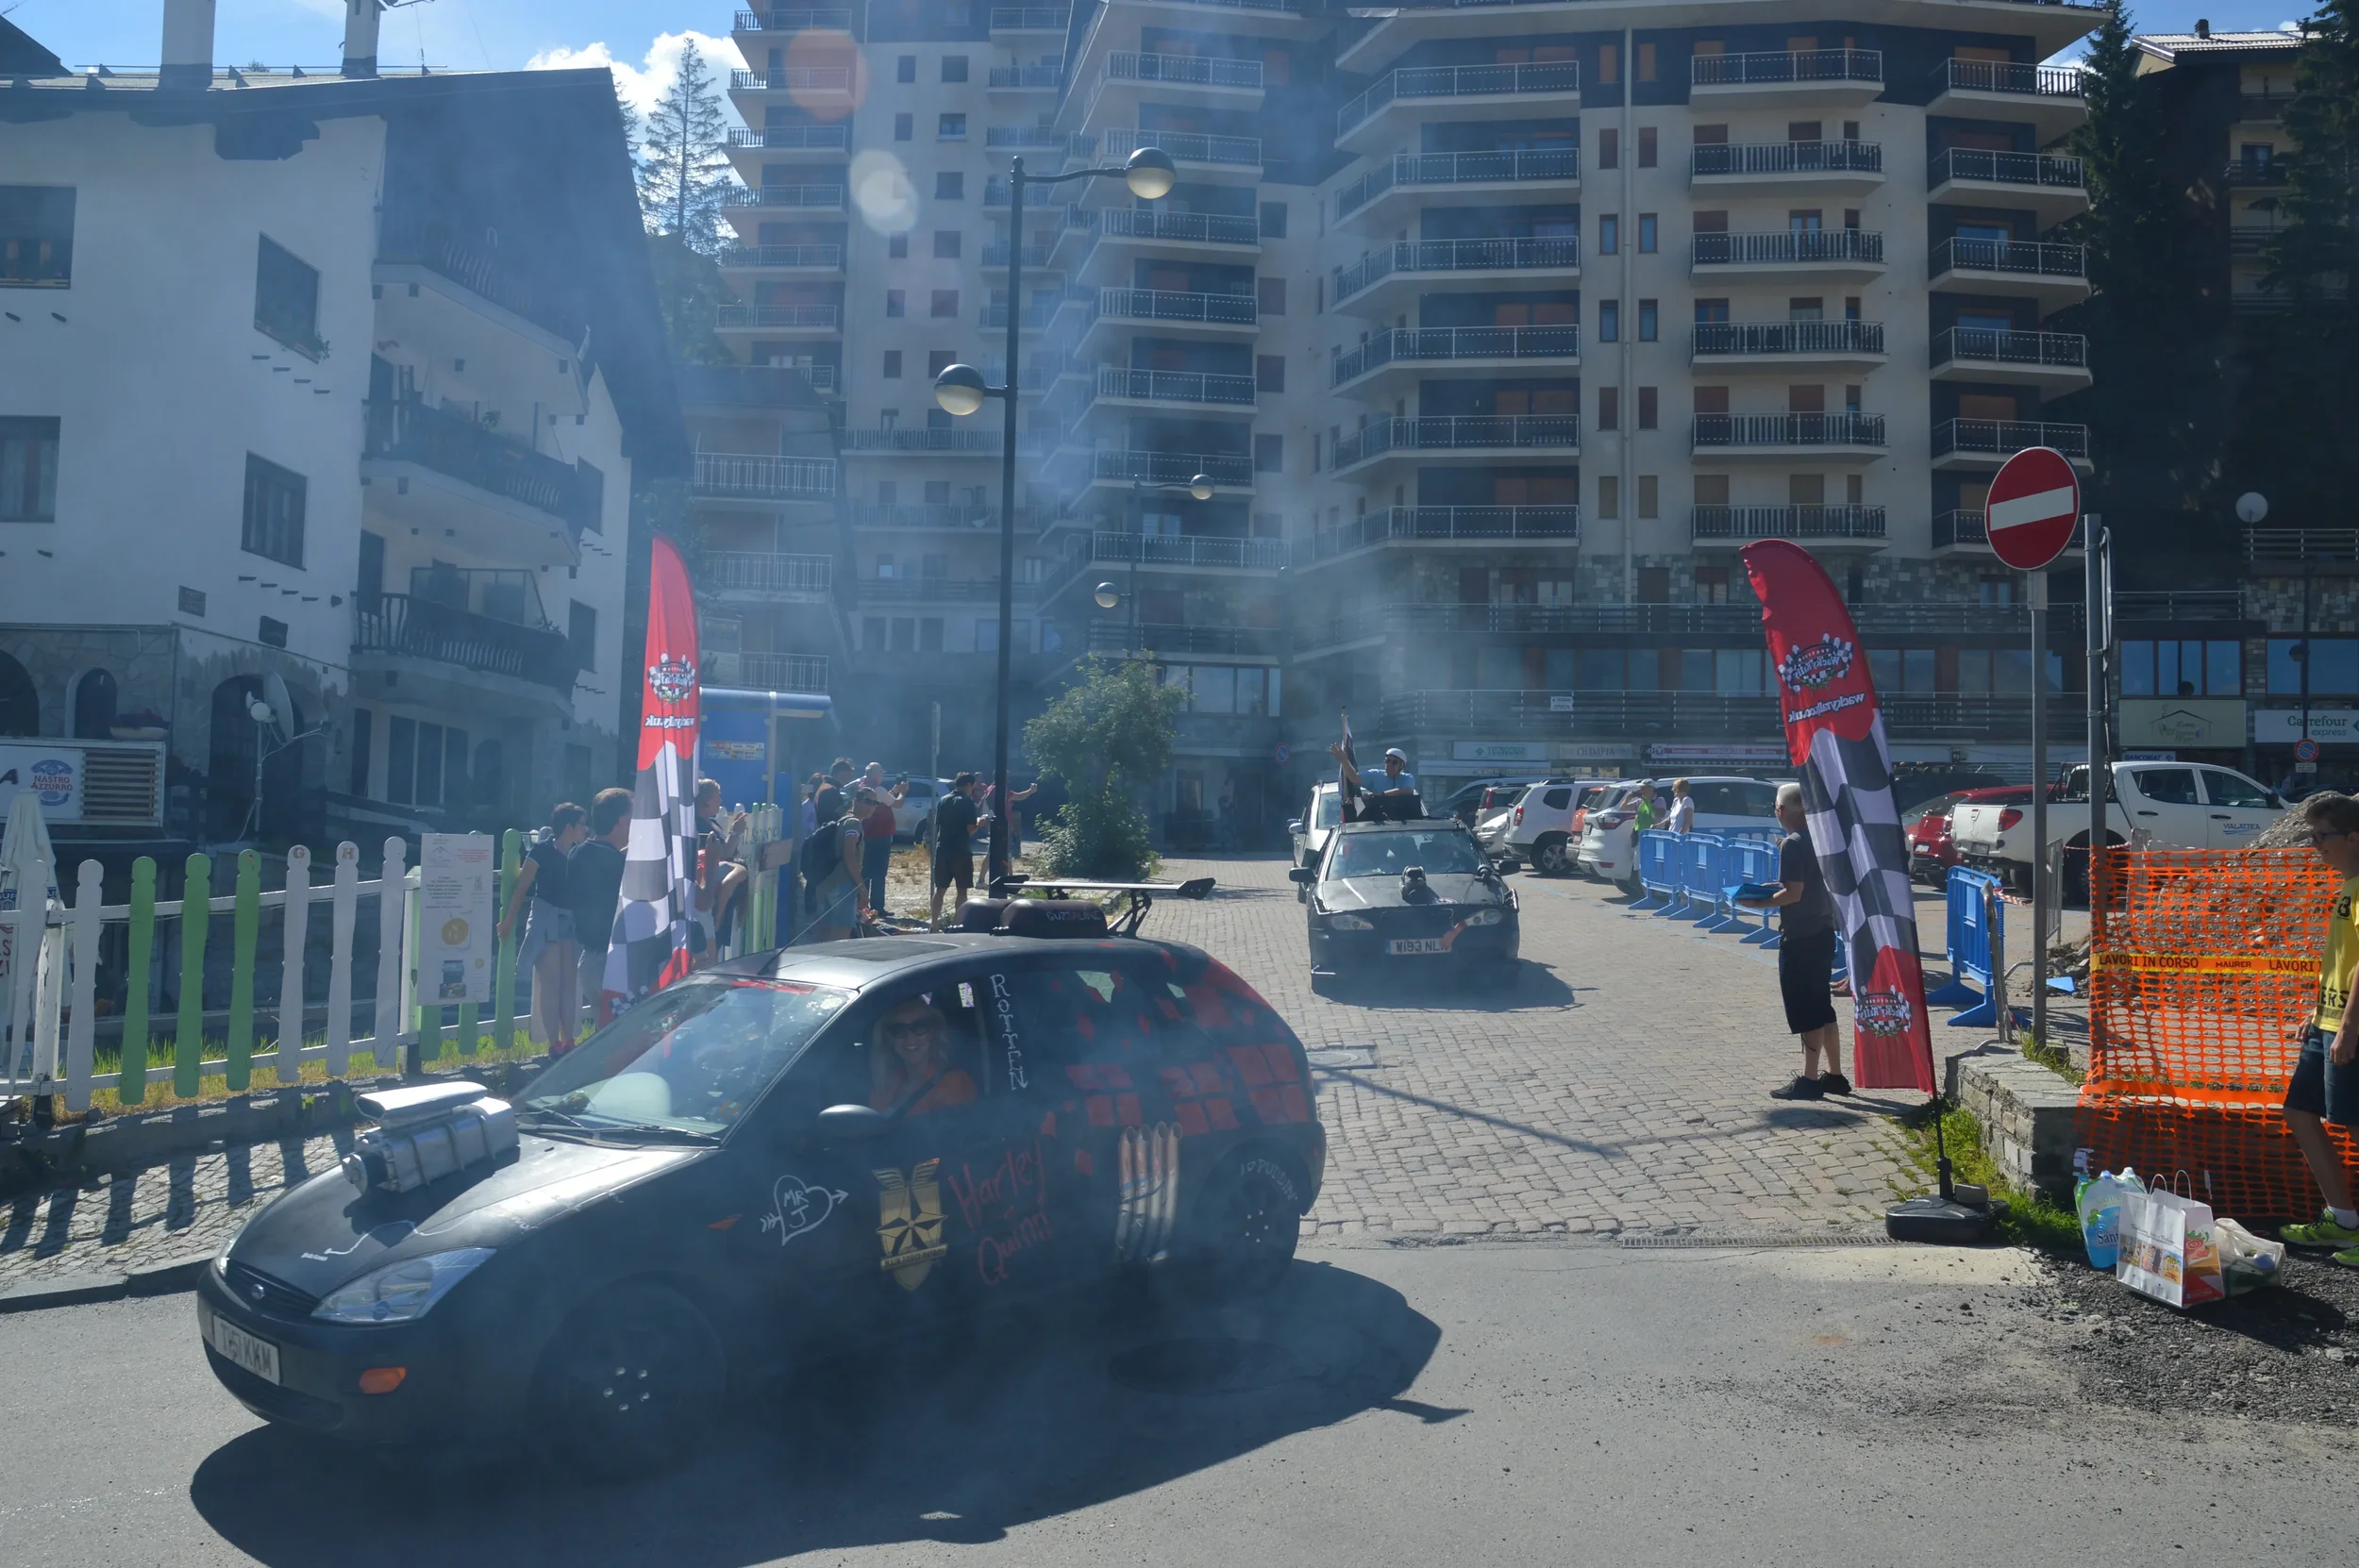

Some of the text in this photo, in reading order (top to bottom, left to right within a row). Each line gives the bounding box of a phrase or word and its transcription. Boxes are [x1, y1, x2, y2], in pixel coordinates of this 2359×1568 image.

[2286, 715, 2348, 726] Carefour
[2312, 728, 2347, 738] express
[1577, 746, 1615, 756] OLIMPIA
[30, 781, 74, 792] AZZURRO
[34, 775, 70, 785] NASTRO
[2100, 954, 2138, 967] LAVORI
[2143, 957, 2155, 967] IN
[2159, 958, 2199, 968] CORSO
[2269, 959, 2315, 972] LAVORI
[947, 1143, 1045, 1232] Harley
[784, 1190, 809, 1207] MR
[790, 1204, 809, 1228] J
[978, 1210, 1052, 1286] Quinn
